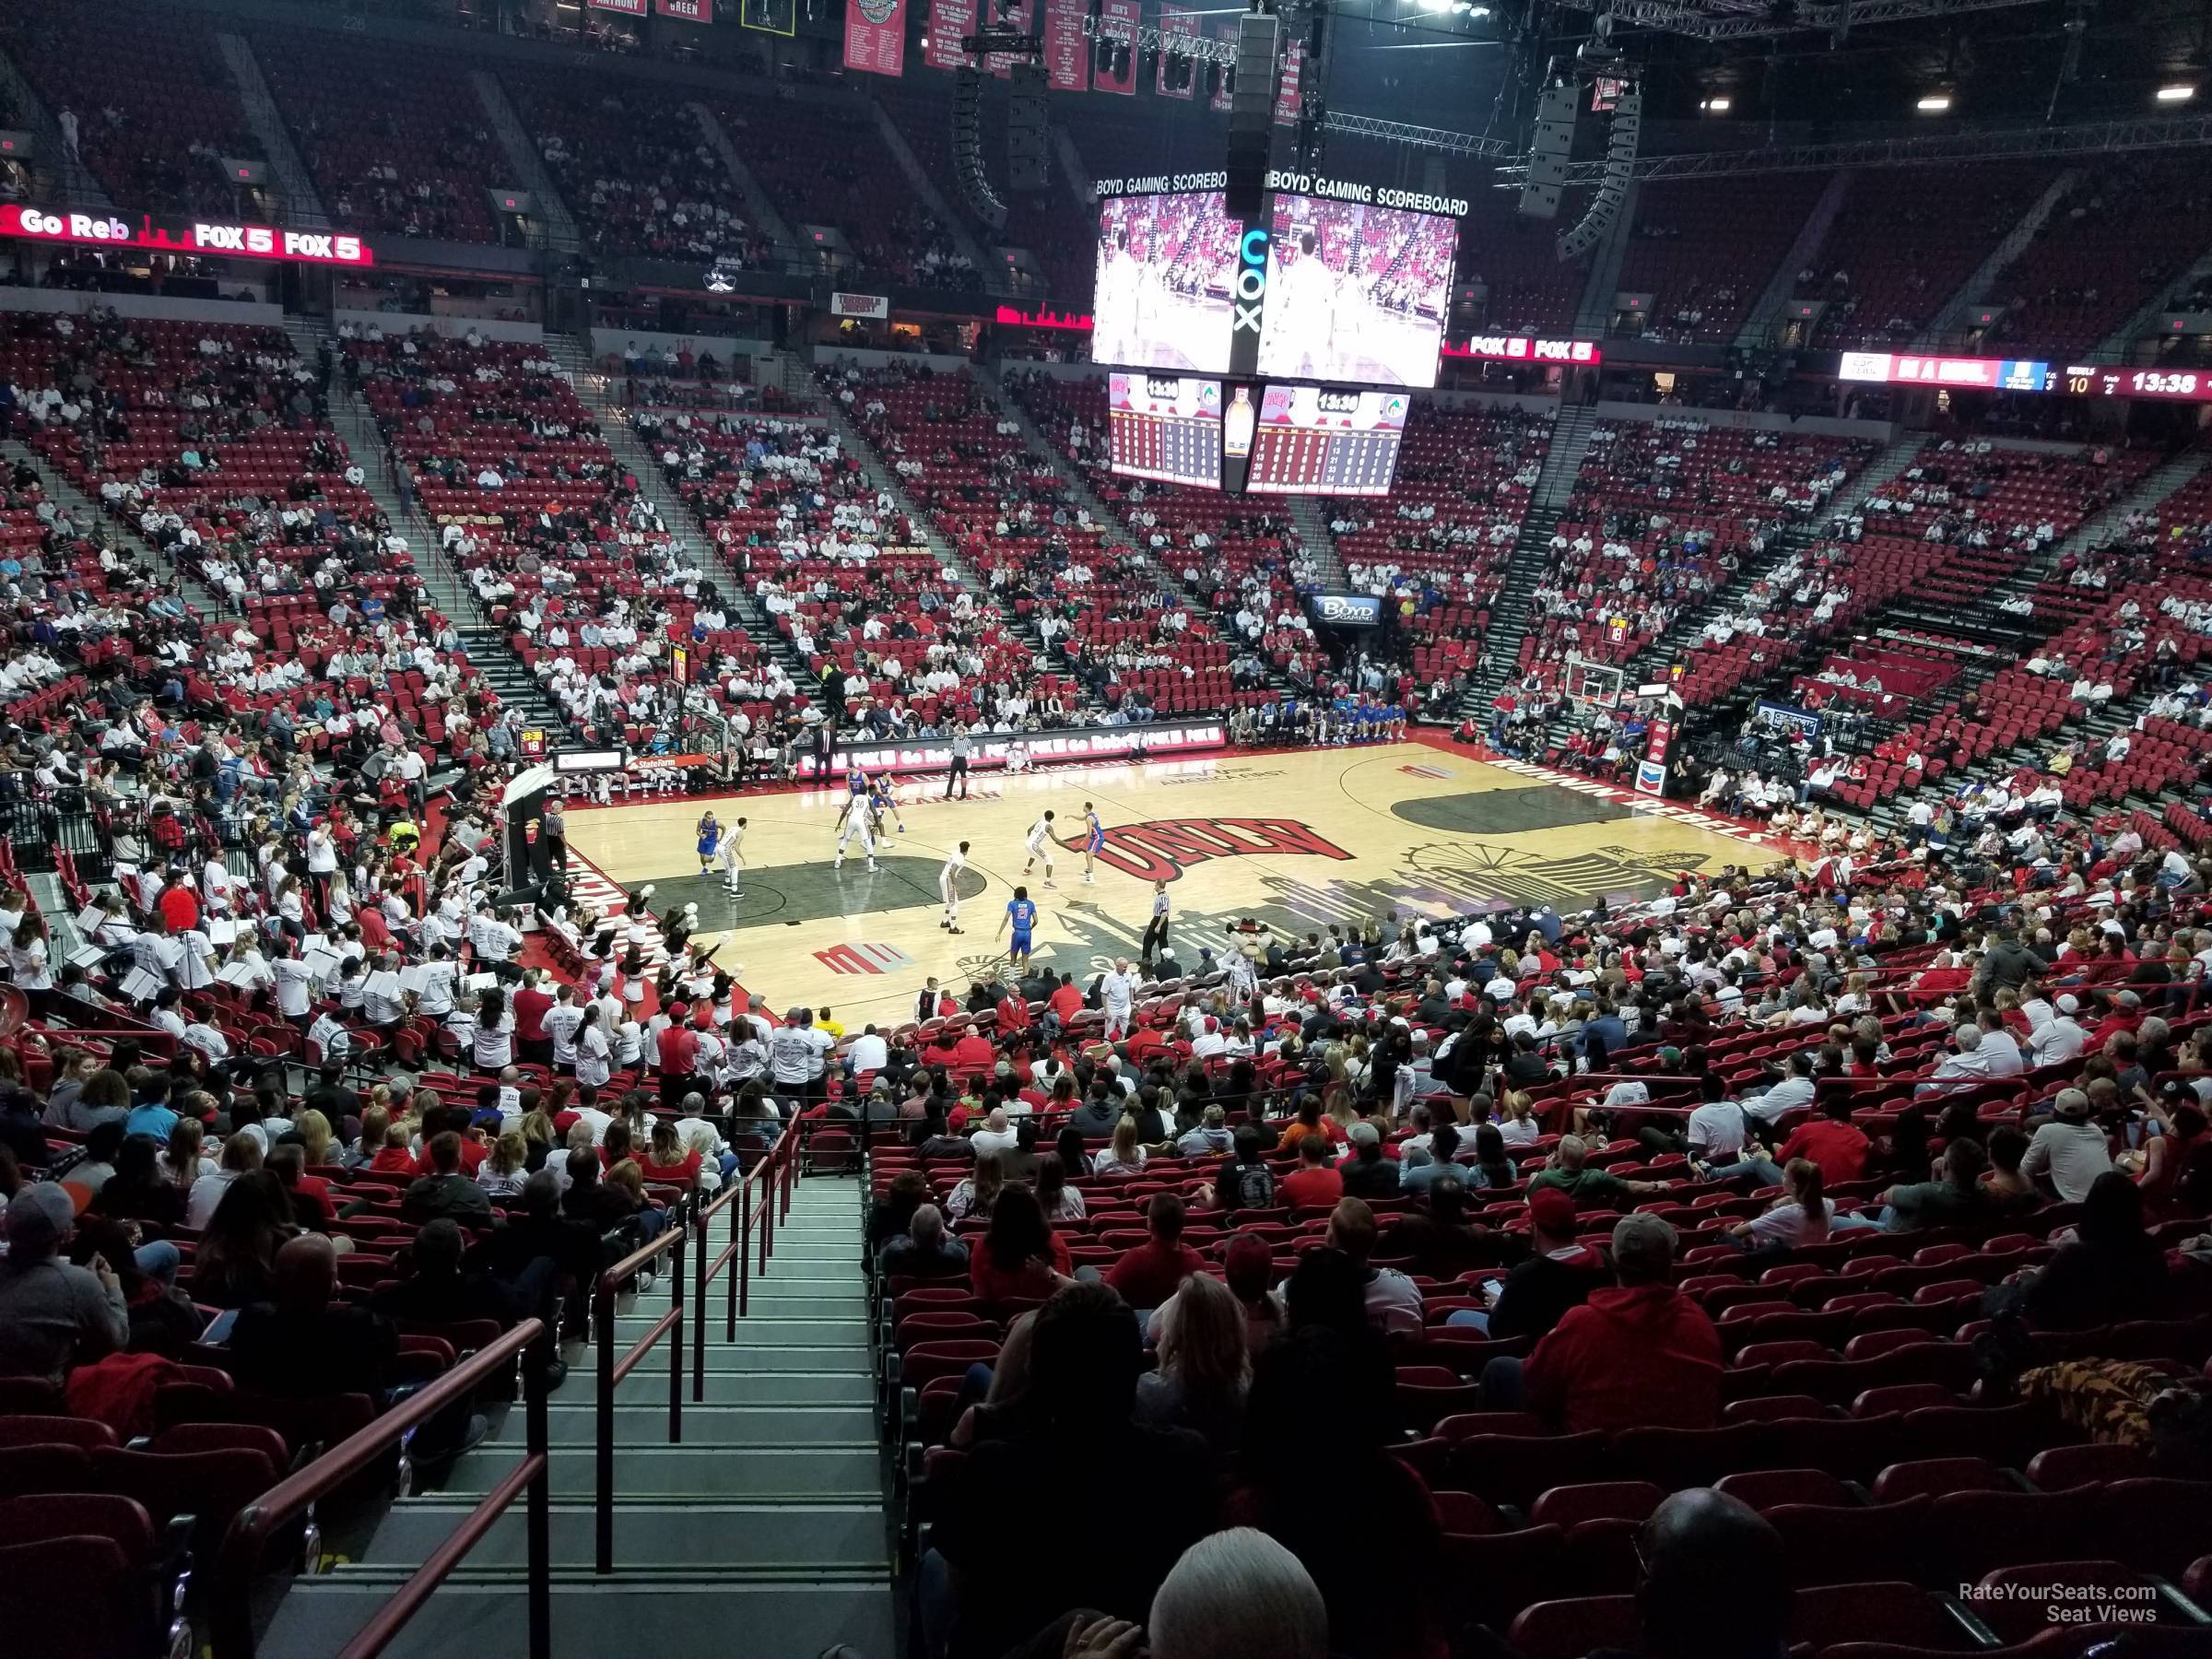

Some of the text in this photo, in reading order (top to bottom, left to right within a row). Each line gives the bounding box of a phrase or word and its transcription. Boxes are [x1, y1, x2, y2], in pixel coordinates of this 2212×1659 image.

[670, 1, 698, 16] GREEN
[1097, 171, 1227, 194] BOYD GAMING SCOREBO
[1270, 170, 1468, 216] BOYD GAMING SCOREBOARD
[19, 208, 129, 240] Go Reb
[195, 224, 274, 253] FOX 5
[285, 232, 360, 260] FOX 5
[1233, 230, 1267, 333] COX
[1470, 336, 1506, 355] FOX
[1535, 340, 1571, 359] FOX
[2067, 367, 2096, 376] REBELS
[2046, 380, 2053, 390] 3
[2068, 377, 2088, 393] 10
[2104, 385, 2113, 394] 2
[1324, 601, 1374, 617] BOYD
[1612, 628, 1622, 641] 18
[528, 741, 539, 751] 18
[1029, 762, 1086, 775] Mack
[1160, 772, 1237, 785] AMERICA
[1240, 770, 1288, 780] FIRST
[855, 800, 865, 808] 30
[1486, 759, 1777, 843] RUNNIN' REBELS
[1056, 818, 1358, 882] UNLV
[1017, 908, 1029, 920] 21
